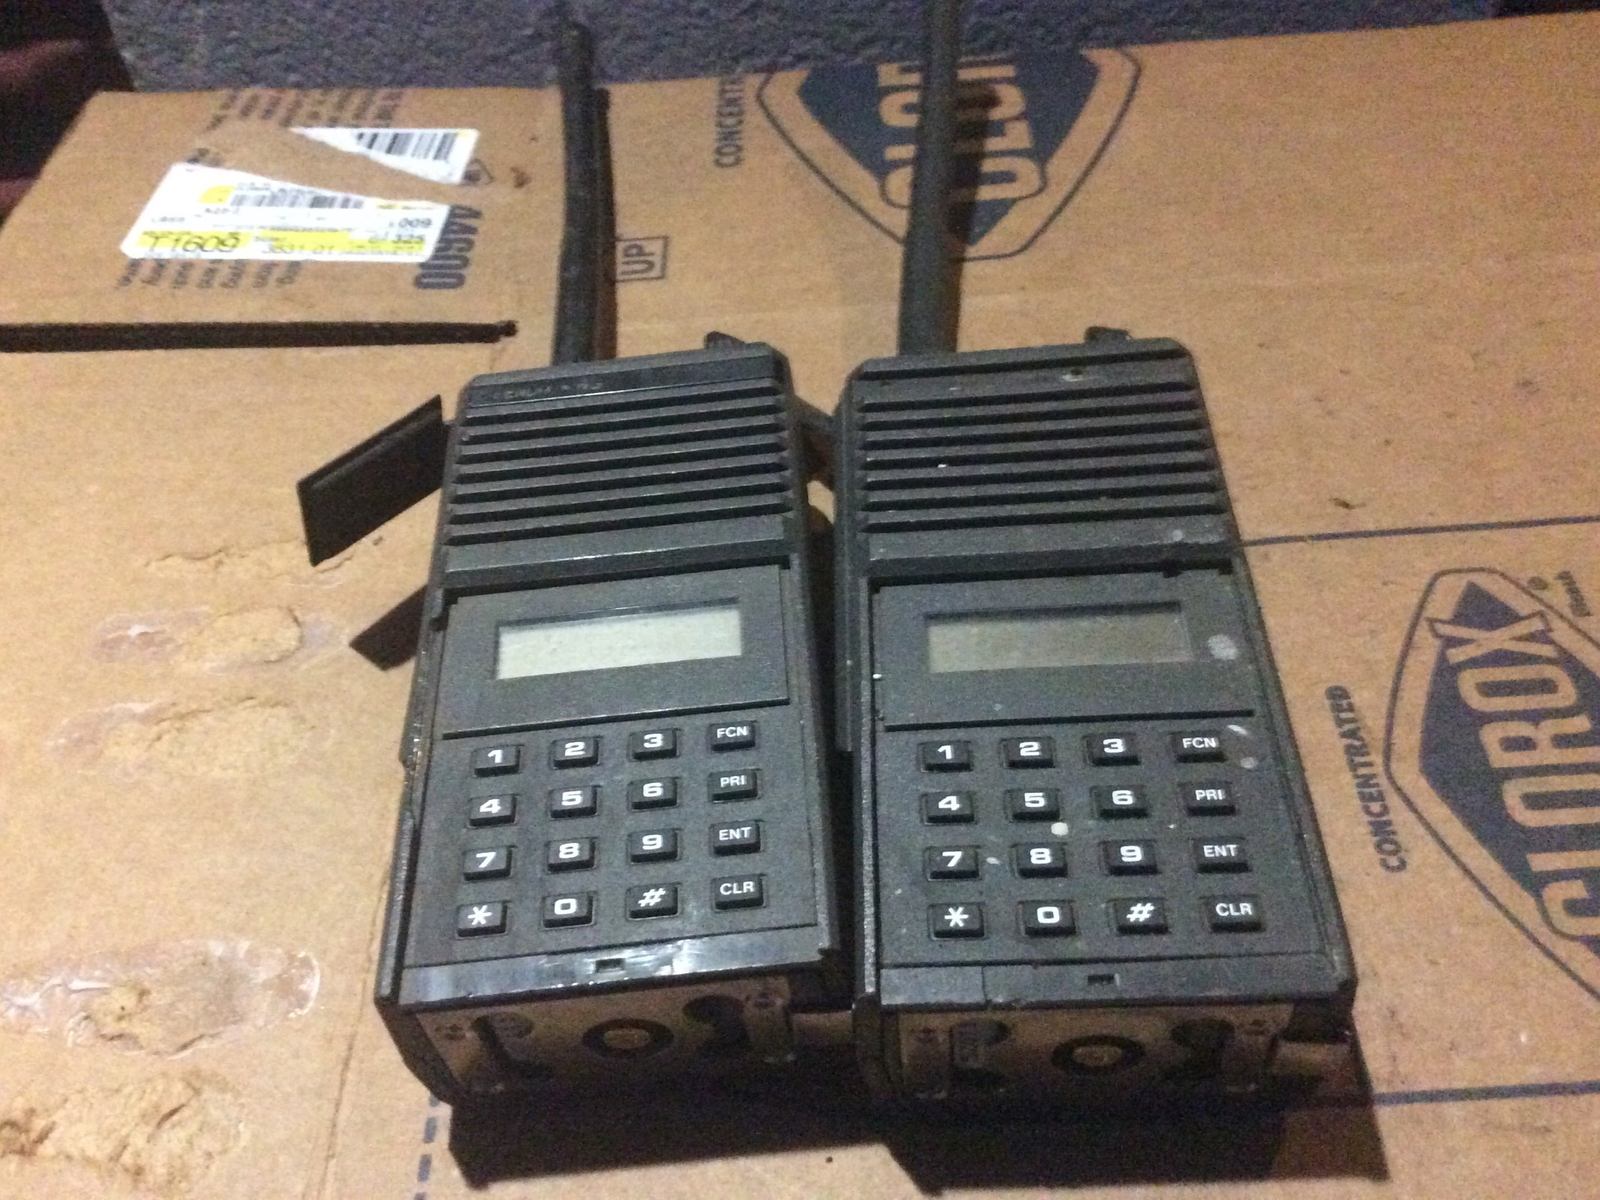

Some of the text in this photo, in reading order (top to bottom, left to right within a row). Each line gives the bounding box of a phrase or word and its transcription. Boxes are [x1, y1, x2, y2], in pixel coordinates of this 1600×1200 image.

[624, 240, 658, 279] UP
[487, 725, 749, 764] 1 2 3 FCN
[937, 737, 1217, 760] 1 2 3 FCN
[479, 774, 746, 814] 4 5 6 PRI
[1325, 685, 1408, 874] CONCENTRATED
[1426, 612, 1600, 938] CLOROX
[938, 789, 1223, 811] 4 5 6 PRI
[475, 826, 752, 869] 7 8 9 ENT
[942, 844, 1237, 868] 7 8 9 ENT
[554, 898, 578, 915] 0
[719, 880, 755, 896] CLR
[1036, 906, 1061, 924] 0
[1215, 902, 1253, 917] CLR
